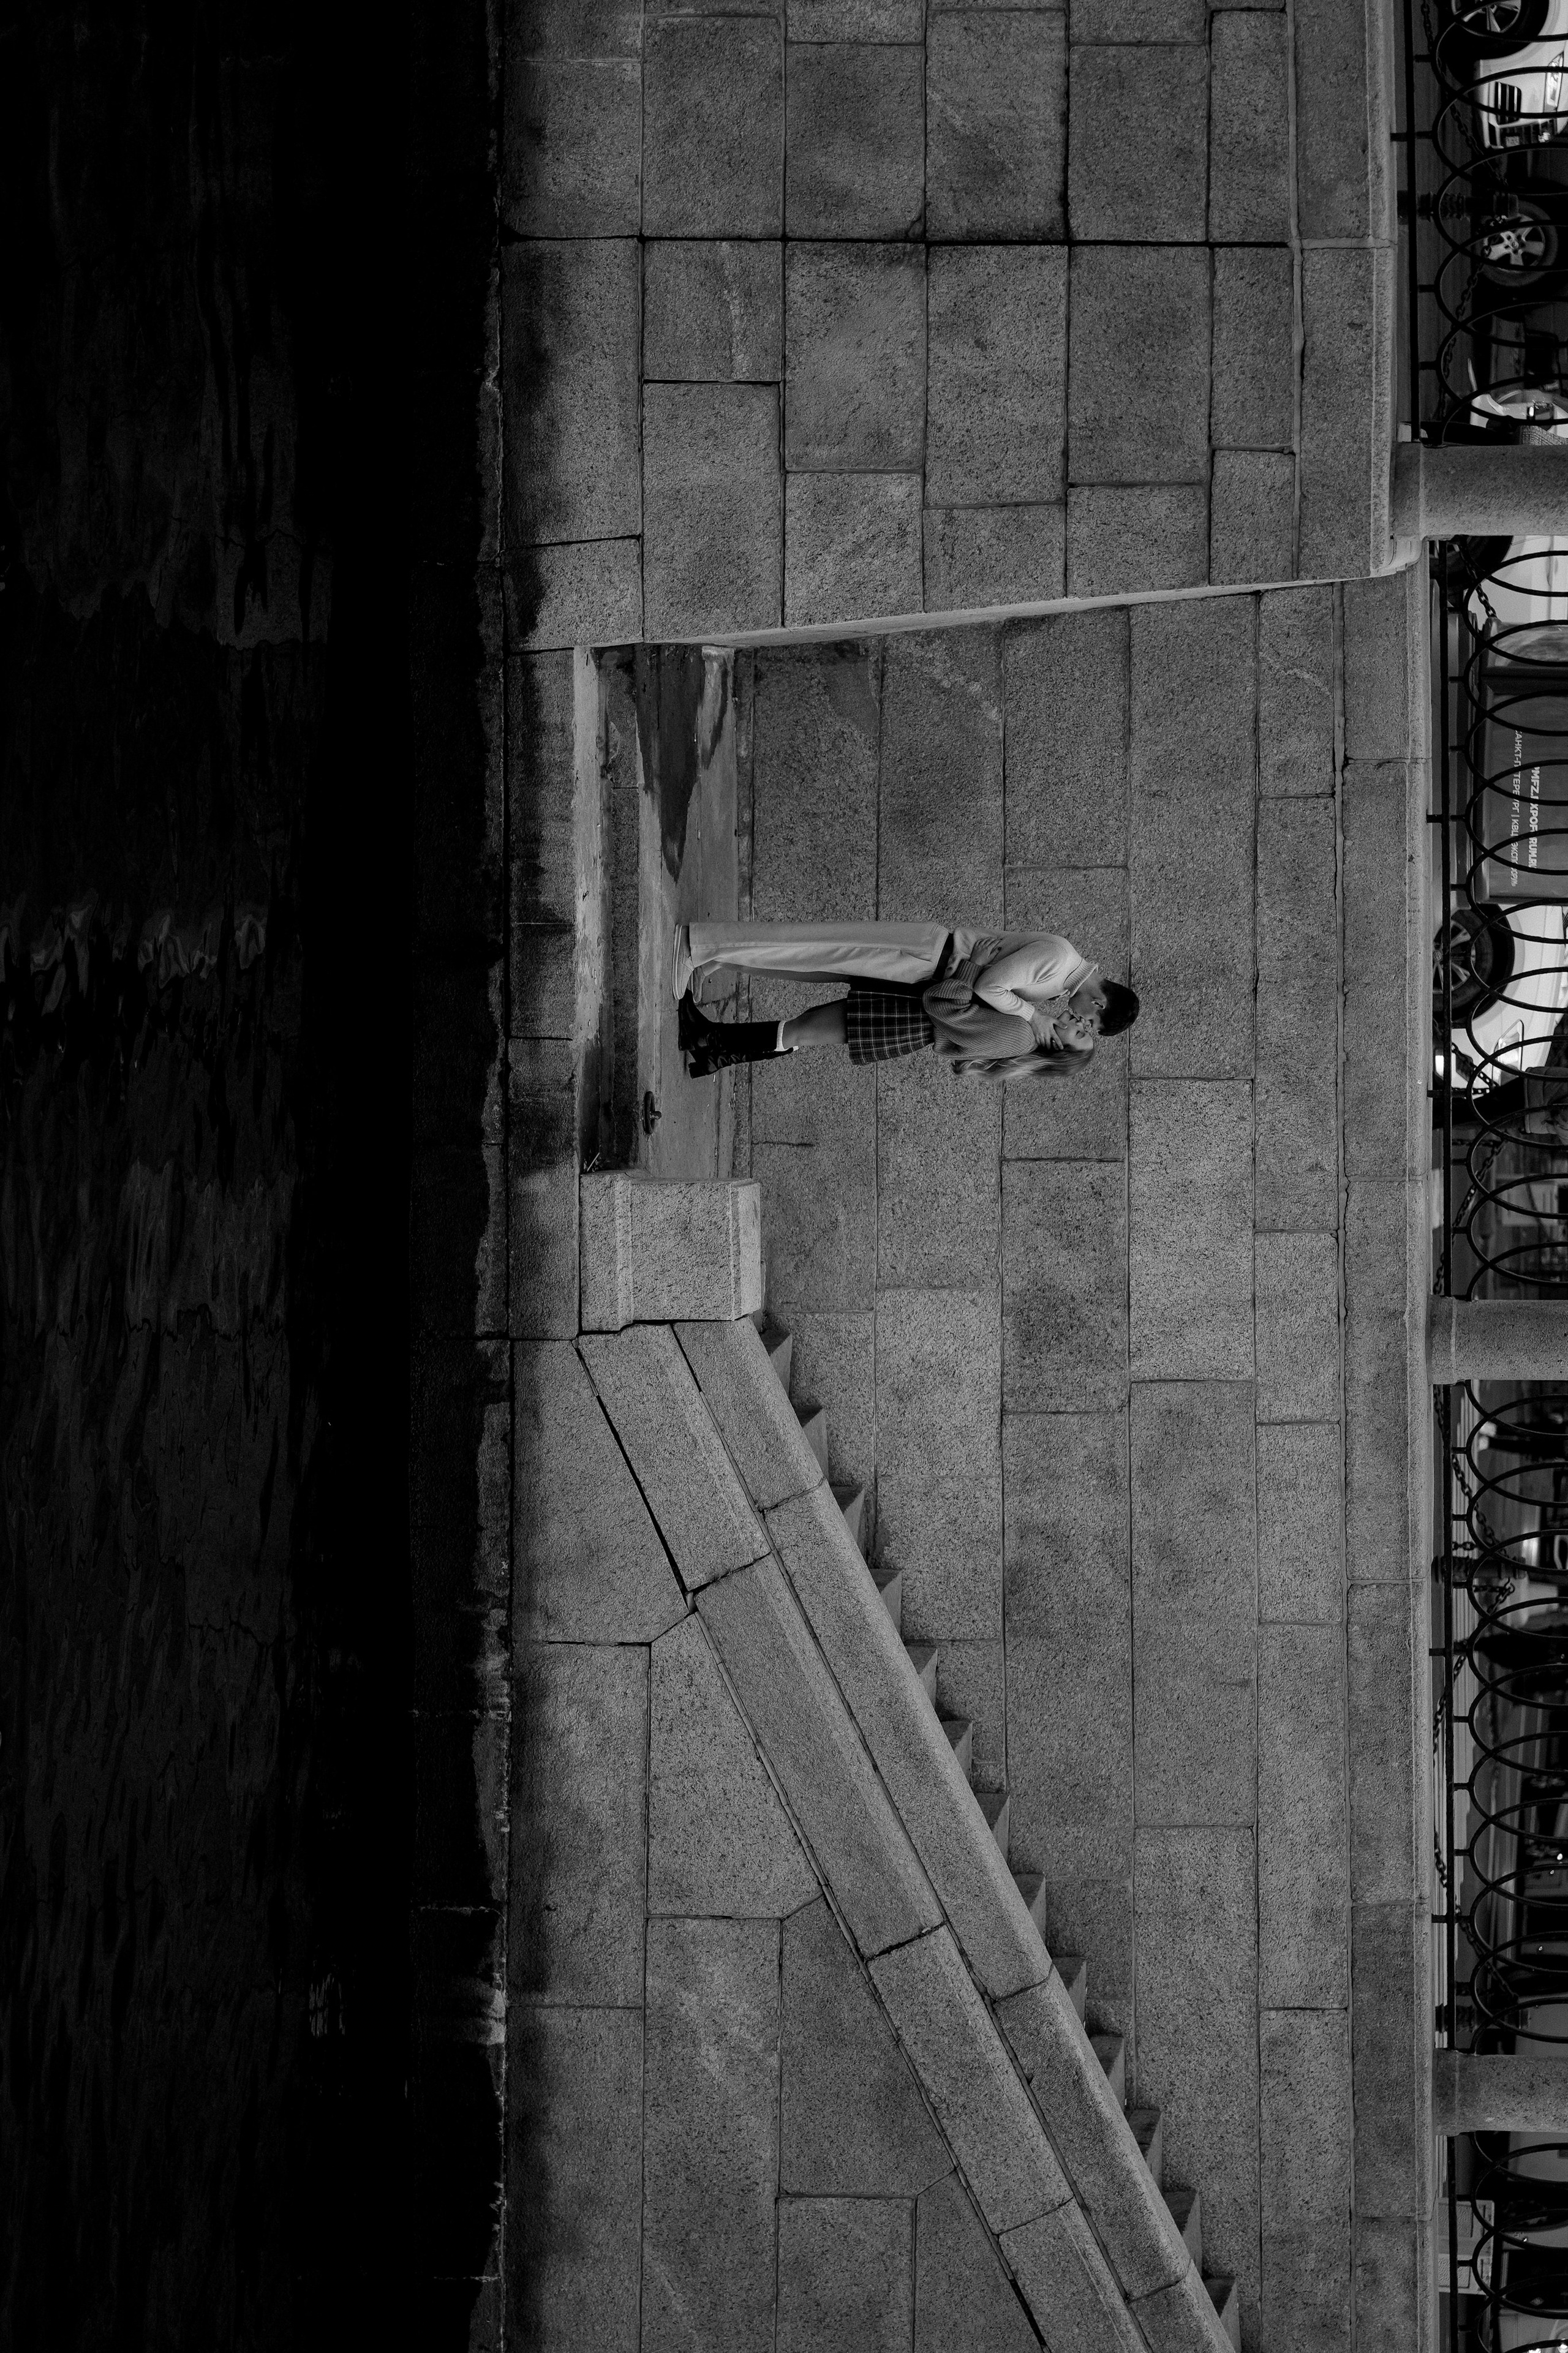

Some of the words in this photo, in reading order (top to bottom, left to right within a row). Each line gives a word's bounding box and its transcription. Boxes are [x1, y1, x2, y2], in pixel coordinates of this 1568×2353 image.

[1512, 730, 1523, 813] АНКТ-ПТЕРБРГ
[1510, 818, 1519, 837] КВЦ
[1528, 766, 1540, 868] PMFZ.XPOFRUM.RU
